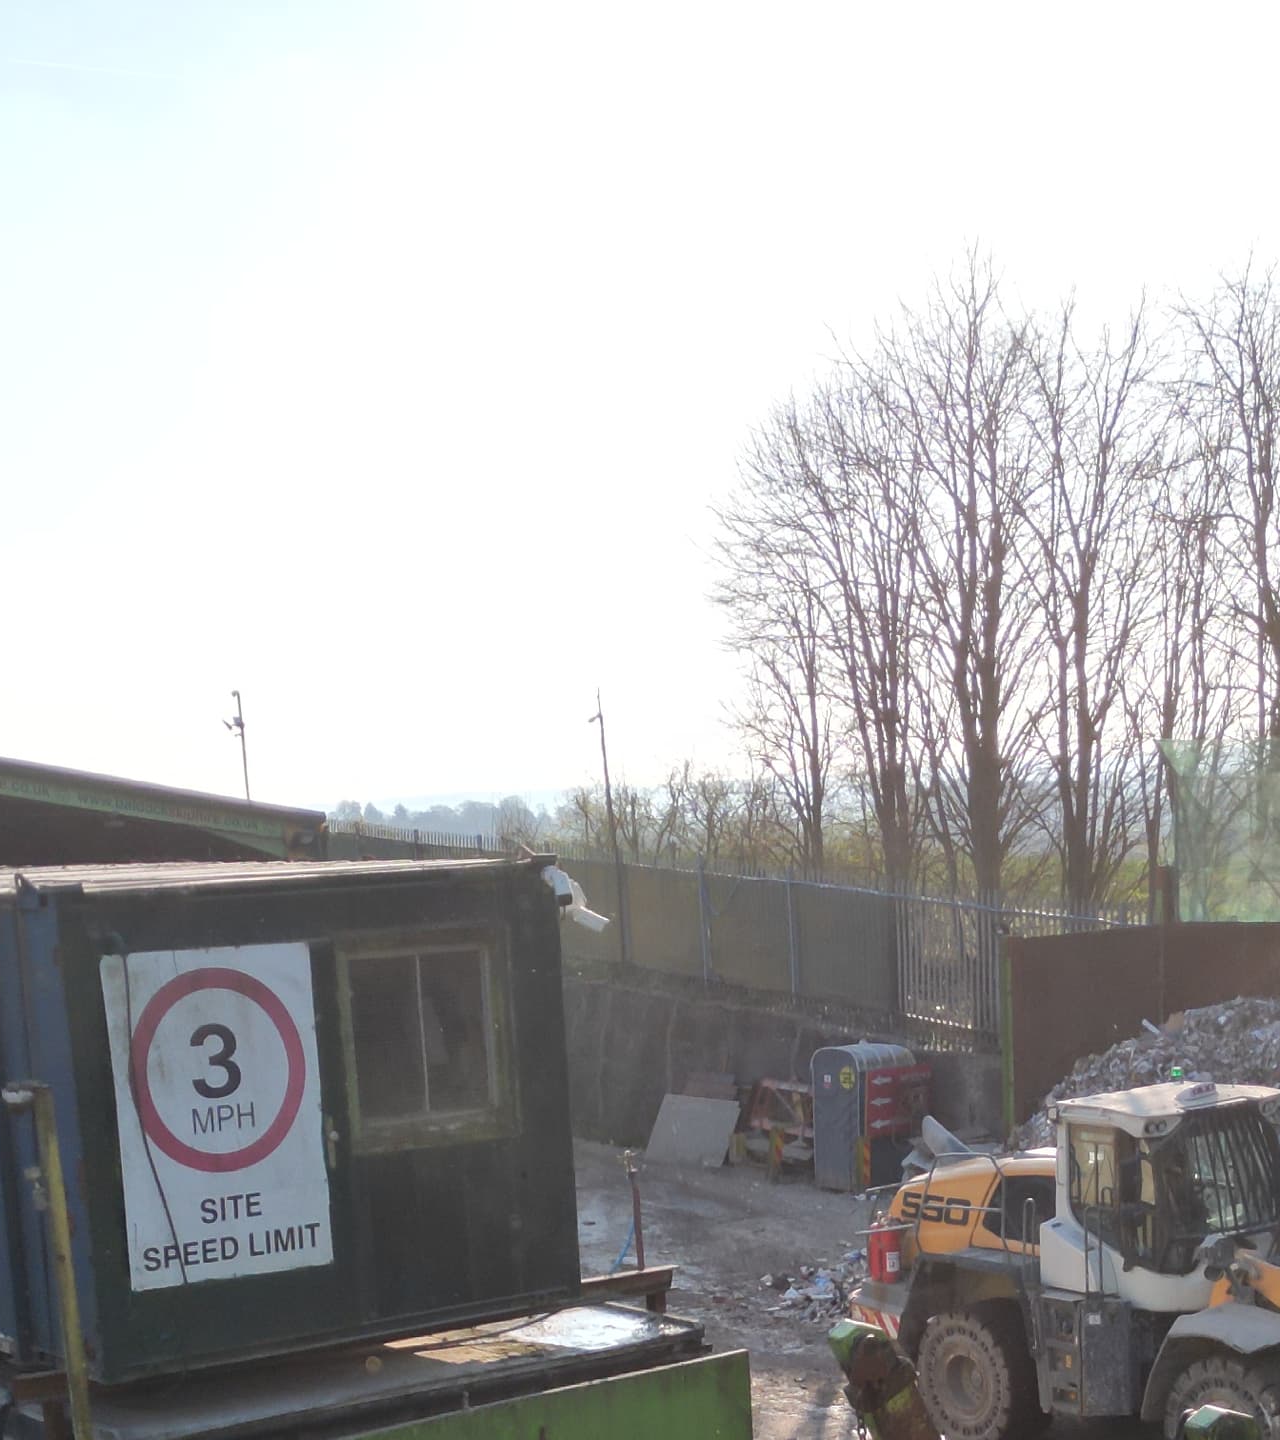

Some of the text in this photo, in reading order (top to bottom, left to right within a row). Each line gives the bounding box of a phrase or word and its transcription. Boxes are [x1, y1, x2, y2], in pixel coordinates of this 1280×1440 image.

[189, 1023, 242, 1099] 3
[192, 1101, 256, 1135] MPH
[200, 1192, 263, 1224] SITE
[901, 1191, 972, 1226] 550
[143, 1222, 321, 1272] SPEED LIMIT
